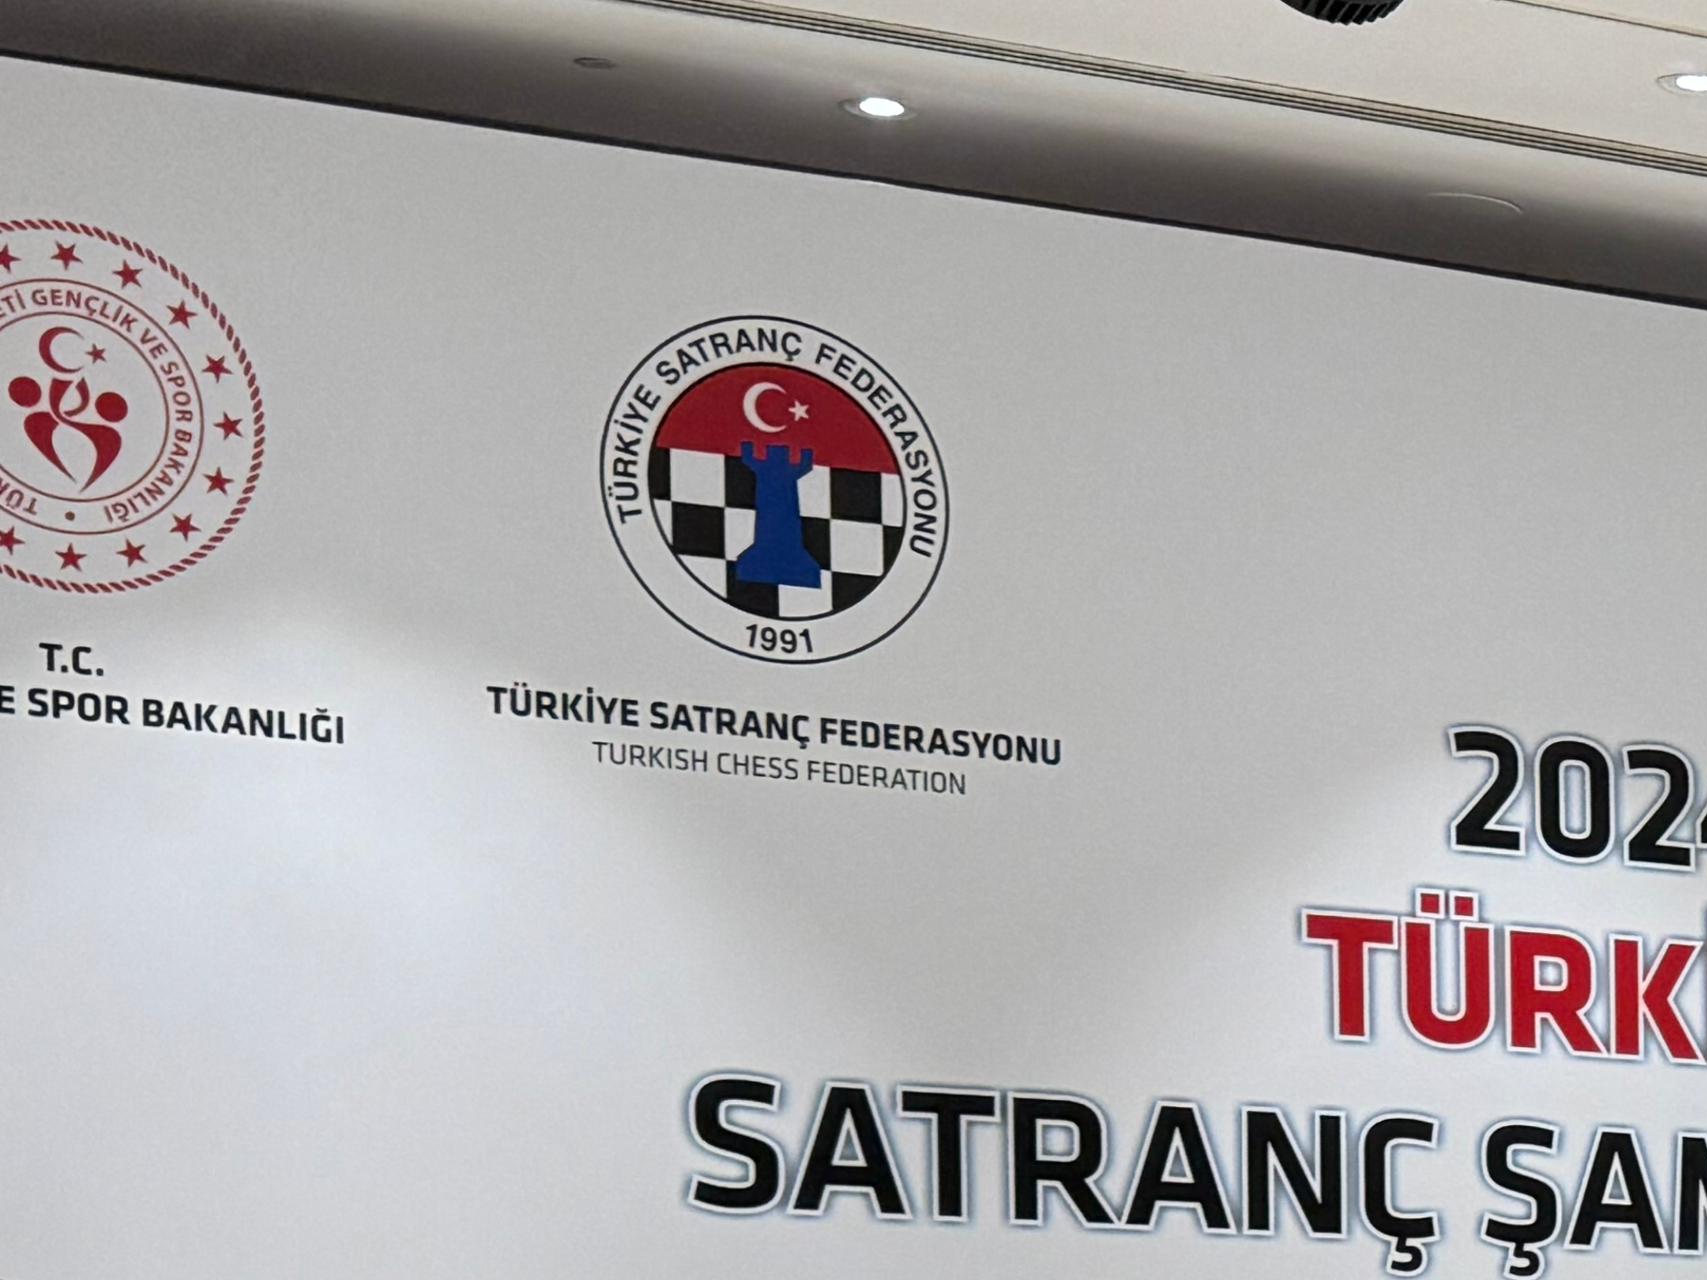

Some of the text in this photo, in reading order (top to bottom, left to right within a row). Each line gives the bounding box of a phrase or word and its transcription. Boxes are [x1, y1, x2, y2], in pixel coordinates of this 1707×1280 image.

[31, 289, 138, 333] GENÇLİK
[139, 328, 169, 360] VE
[160, 361, 194, 424] SPOR
[608, 327, 938, 558] TÜRKİYE SATRANÇ FEDERASYONU
[39, 642, 104, 677] T.C.
[745, 623, 814, 654] 1991
[28, 687, 130, 725] SPOR
[142, 698, 345, 744] BAKANLIĞI
[486, 681, 1062, 766] TÜRKİYE SATRANÇ FEDERASYONU
[592, 741, 967, 796] TURKISH CHESS FEDERATION
[692, 1080, 1434, 1270] SATRANÇ
